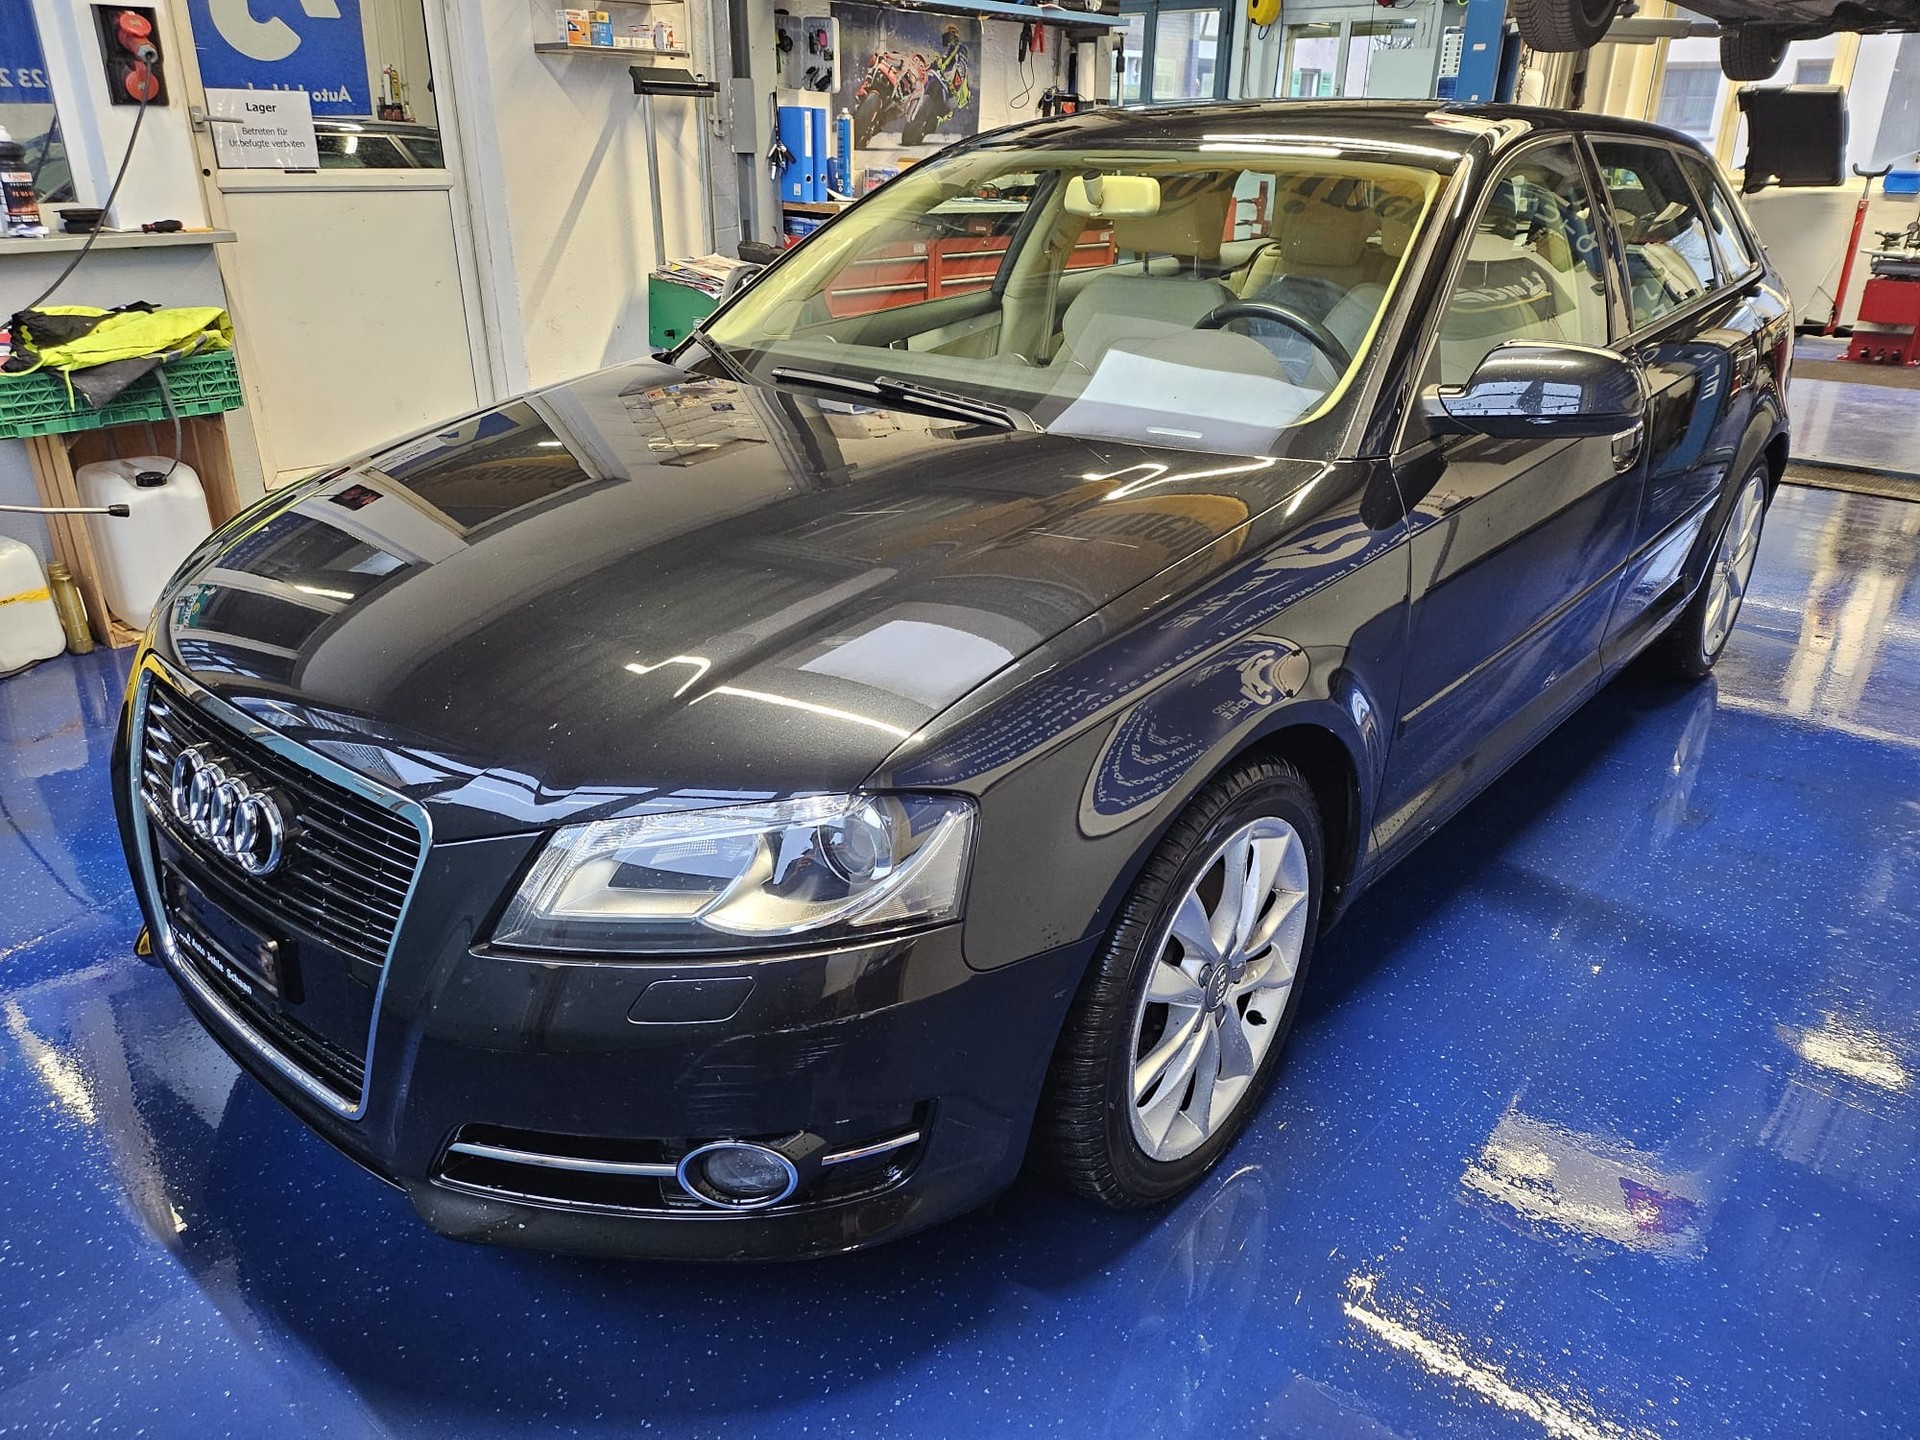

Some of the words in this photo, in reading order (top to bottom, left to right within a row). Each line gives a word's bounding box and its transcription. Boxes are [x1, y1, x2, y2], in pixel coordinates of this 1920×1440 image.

[245, 102, 277, 115] Lager
[241, 127, 276, 136] Betreten
[277, 127, 289, 136] für
[226, 968, 252, 995] Schaan
